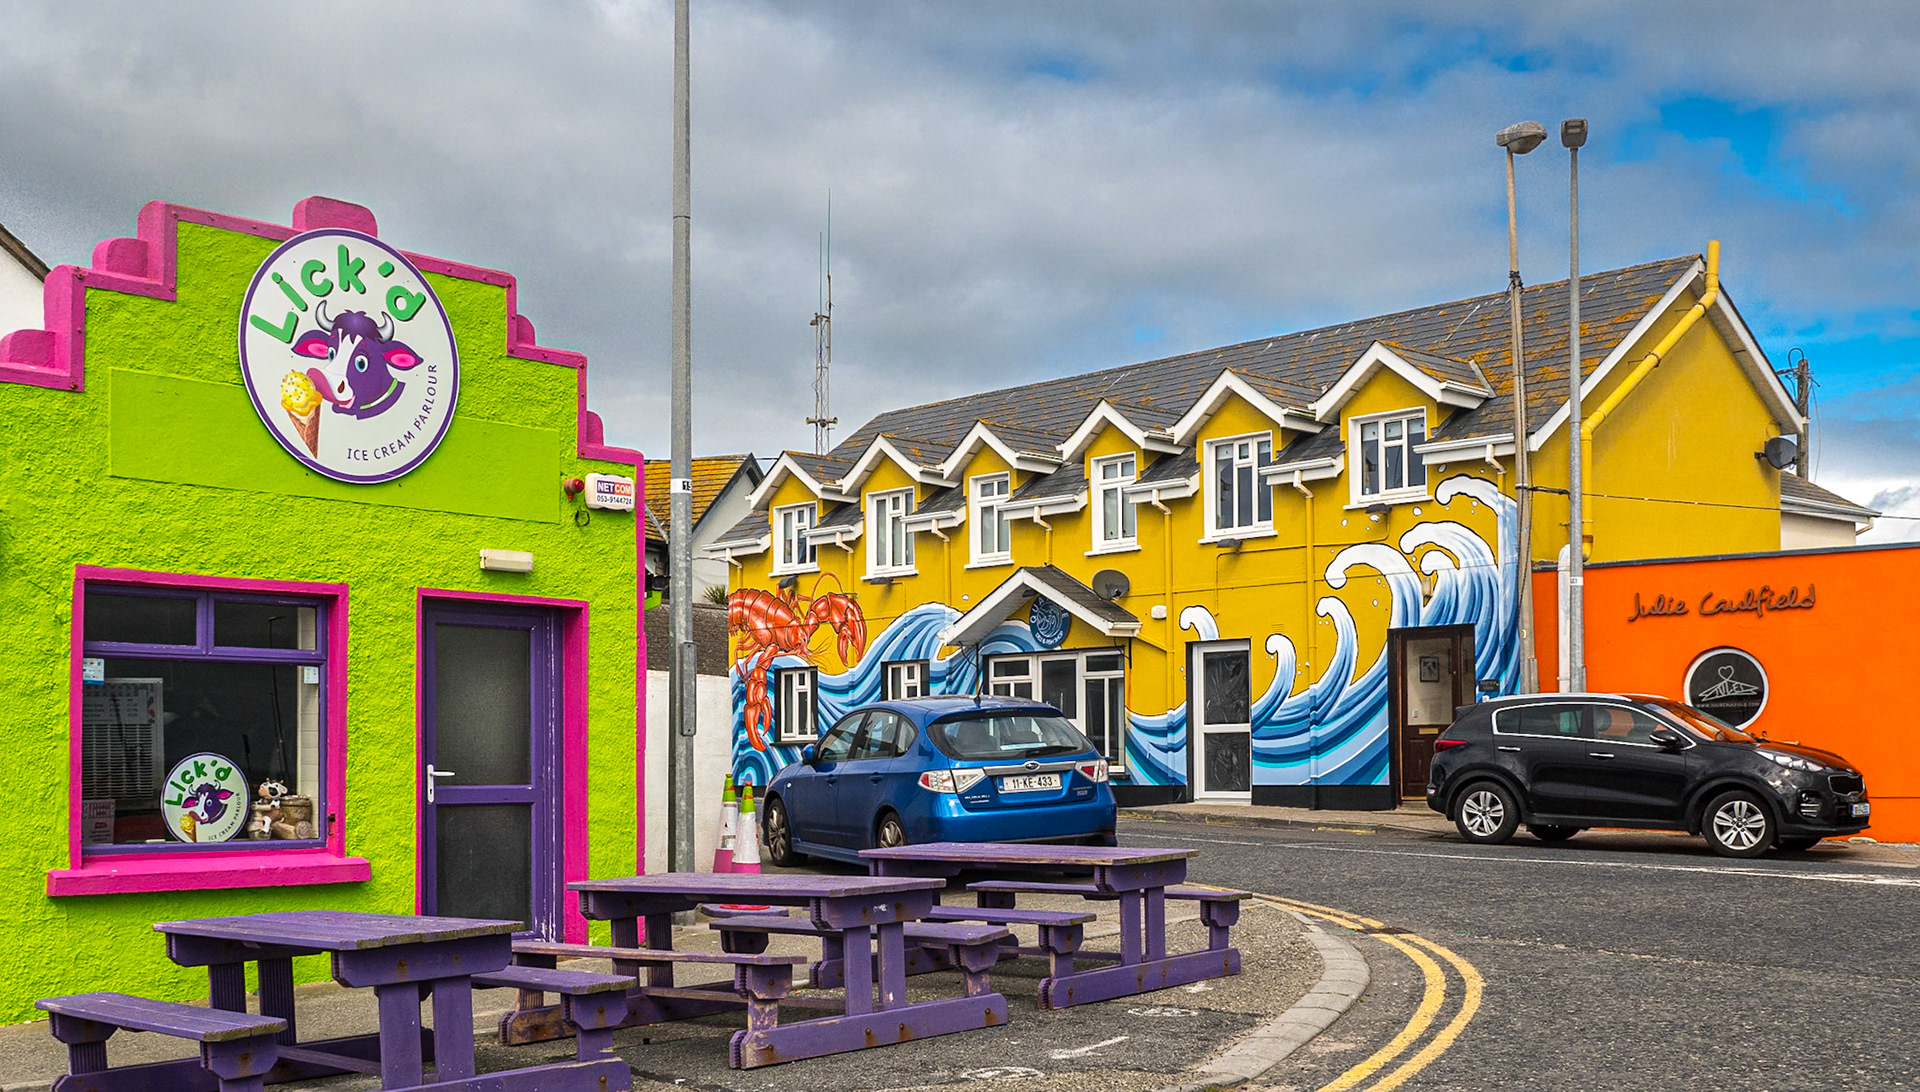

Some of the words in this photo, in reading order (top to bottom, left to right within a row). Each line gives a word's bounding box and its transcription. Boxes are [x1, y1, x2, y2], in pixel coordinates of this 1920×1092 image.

[250, 244, 426, 345] Lick'd
[347, 448, 369, 461] ICE
[373, 430, 415, 460] CREAM
[413, 364, 437, 431] PARLOUR
[597, 481, 632, 496] NETCOM
[1628, 592, 1688, 622] Julie
[1699, 584, 1816, 618] Caulfield
[165, 760, 233, 806] Lick'd
[1012, 776, 1053, 789] 11-KE-433
[208, 833, 218, 841] ICE
[218, 821, 235, 837] CREAM
[233, 792, 242, 820] PARLOUR
